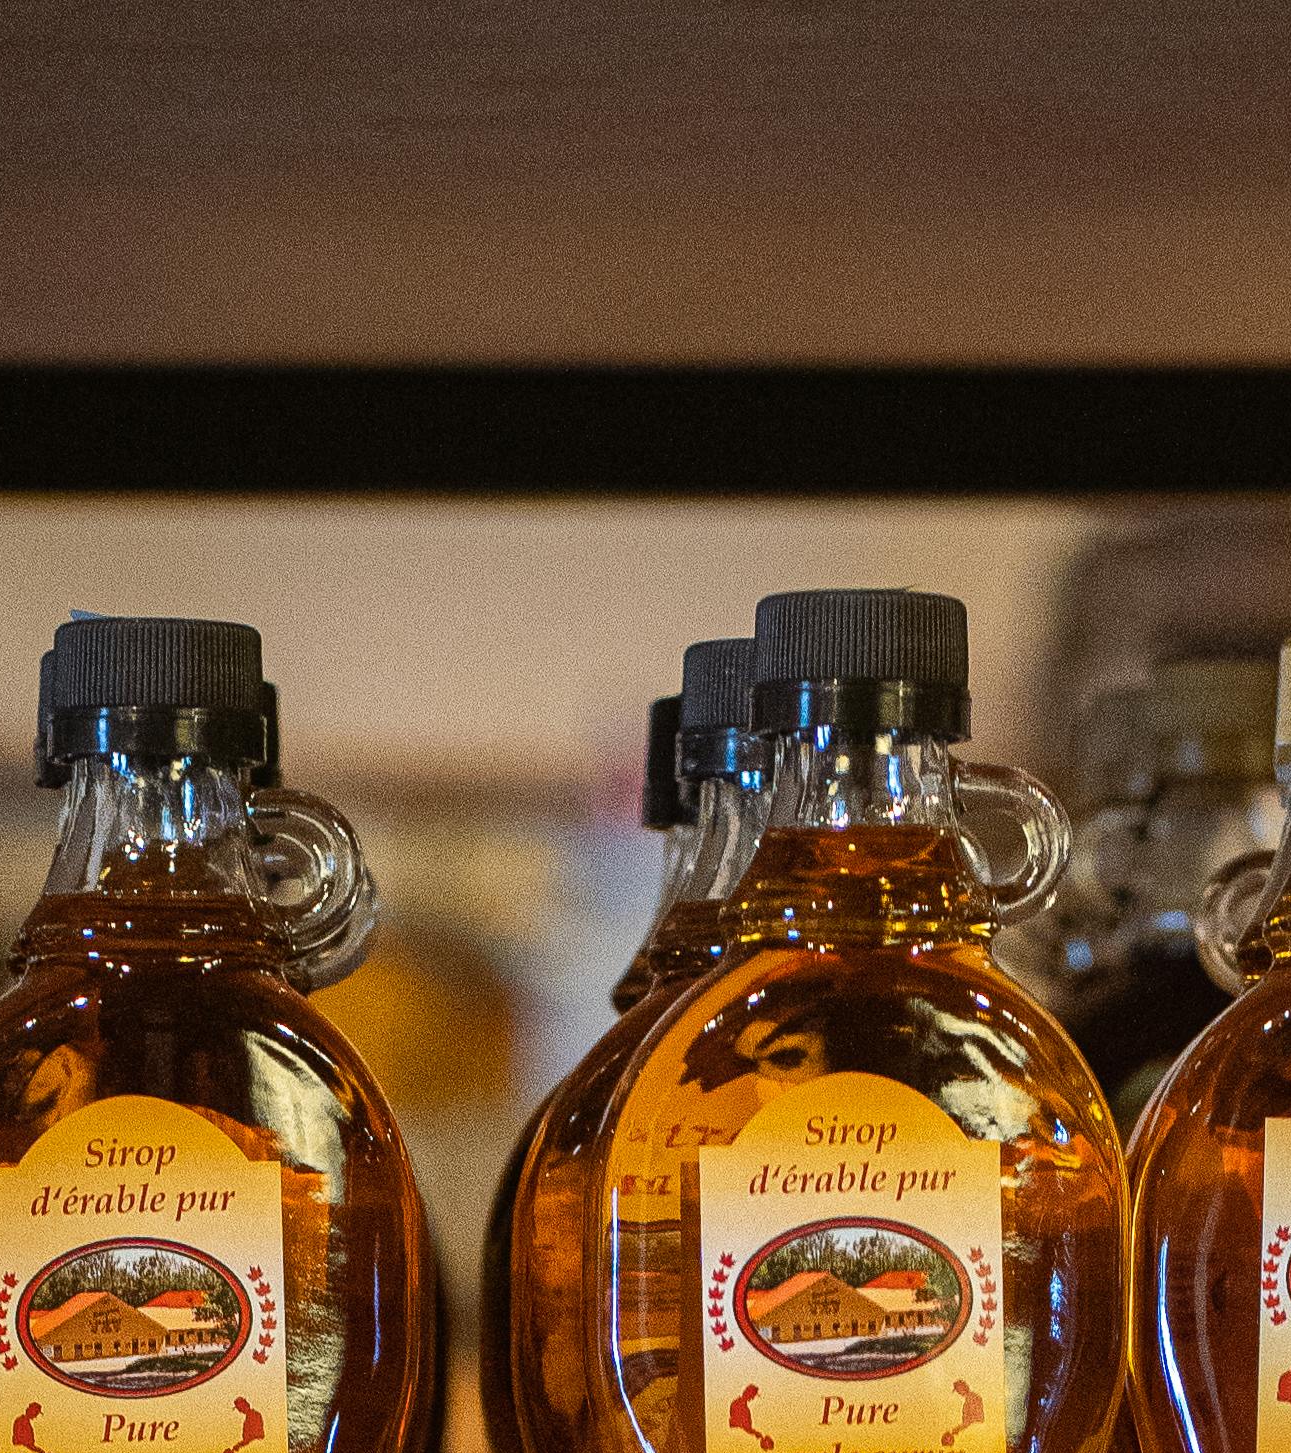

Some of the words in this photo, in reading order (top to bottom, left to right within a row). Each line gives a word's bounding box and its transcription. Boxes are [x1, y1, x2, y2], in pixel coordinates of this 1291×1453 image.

[805, 1115, 898, 1153] Sirop
[85, 1138, 177, 1176] Sirop
[748, 1162, 887, 1197] d'érable
[895, 1169, 956, 1200] pur
[30, 1183, 166, 1217] d'érable
[175, 1188, 235, 1221] pur
[102, 1413, 180, 1443] Pure
[819, 1396, 899, 1425] Pure
